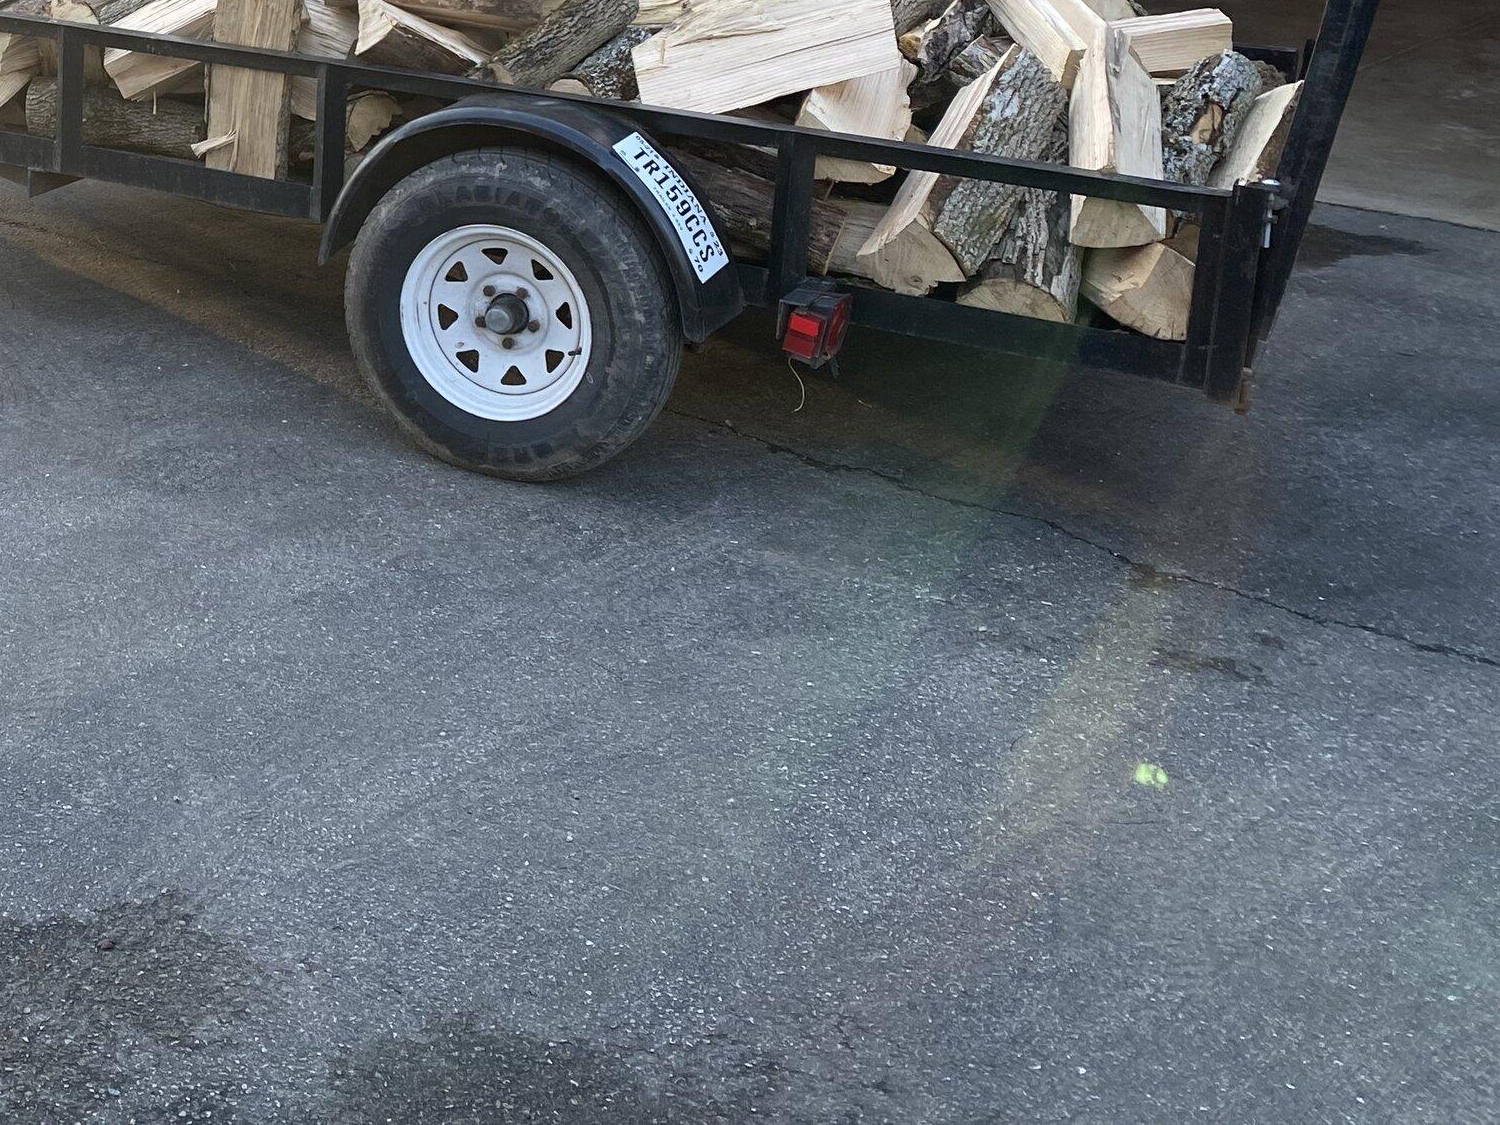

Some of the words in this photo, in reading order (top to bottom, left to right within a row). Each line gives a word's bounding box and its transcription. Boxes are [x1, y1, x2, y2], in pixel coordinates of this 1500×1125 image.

[633, 147, 715, 263] TR159CCS
[664, 165, 707, 224] INDIANA
[713, 241, 723, 256] 23
